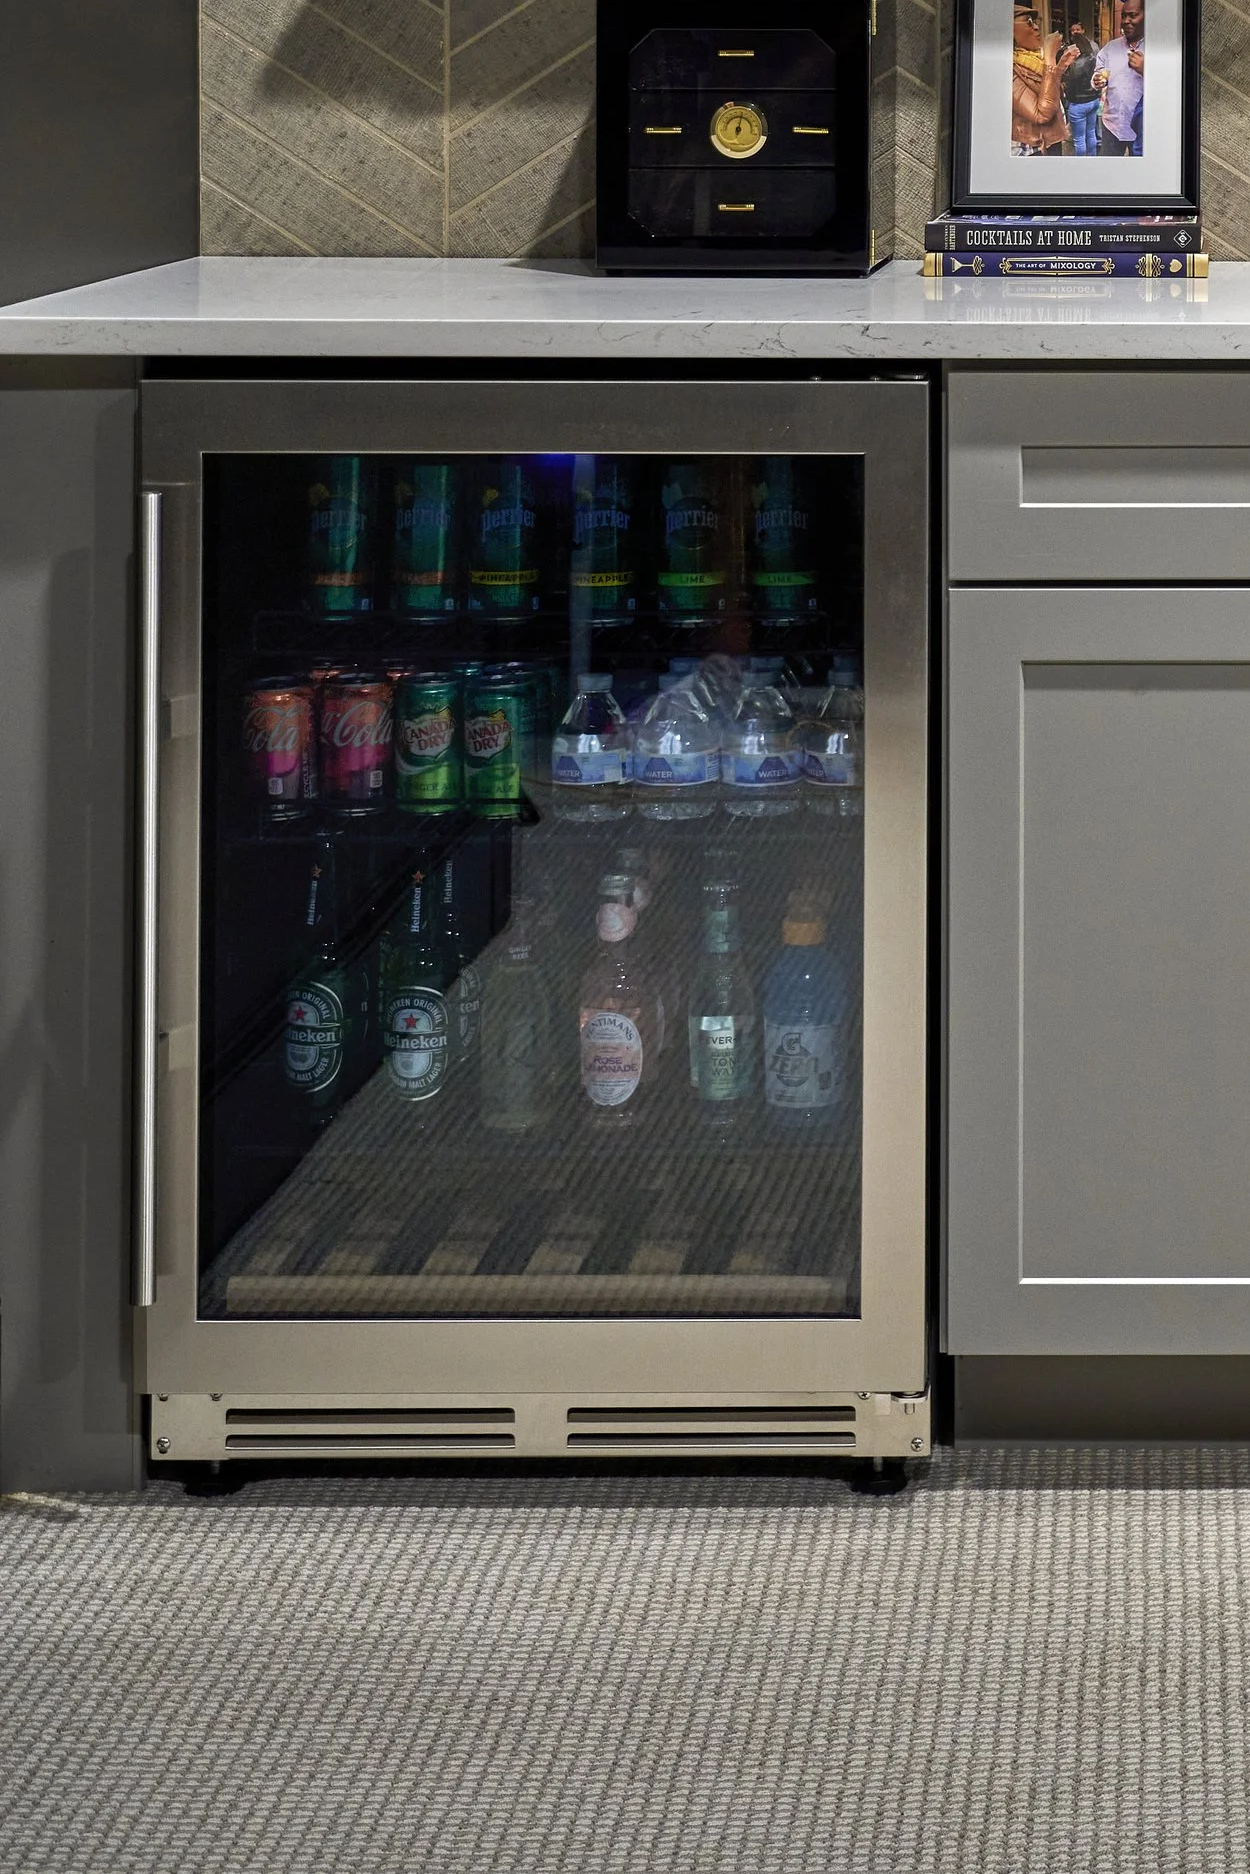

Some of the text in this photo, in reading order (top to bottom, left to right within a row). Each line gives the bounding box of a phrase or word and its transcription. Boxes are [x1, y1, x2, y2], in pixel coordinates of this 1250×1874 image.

[966, 230, 1092, 246] COCKTAILS AT HOME
[1099, 234, 1161, 242] TRISTAN STEPHENSON
[1050, 262, 1097, 270] MIXOLOGY
[664, 505, 720, 546] perrier
[754, 504, 809, 545] perrier
[680, 575, 705, 583] LIME
[417, 734, 447, 751] DRY
[472, 735, 500, 753] DRY
[646, 769, 673, 778] WATER
[758, 768, 787, 778] WATER
[410, 886, 422, 933] Heineken
[301, 991, 331, 1020] ORIGINAL
[413, 997, 443, 1024] ORIGINAL
[383, 1031, 448, 1049] Heineken
[593, 1055, 623, 1065] ROSE
[426, 1061, 443, 1084] LAGER
